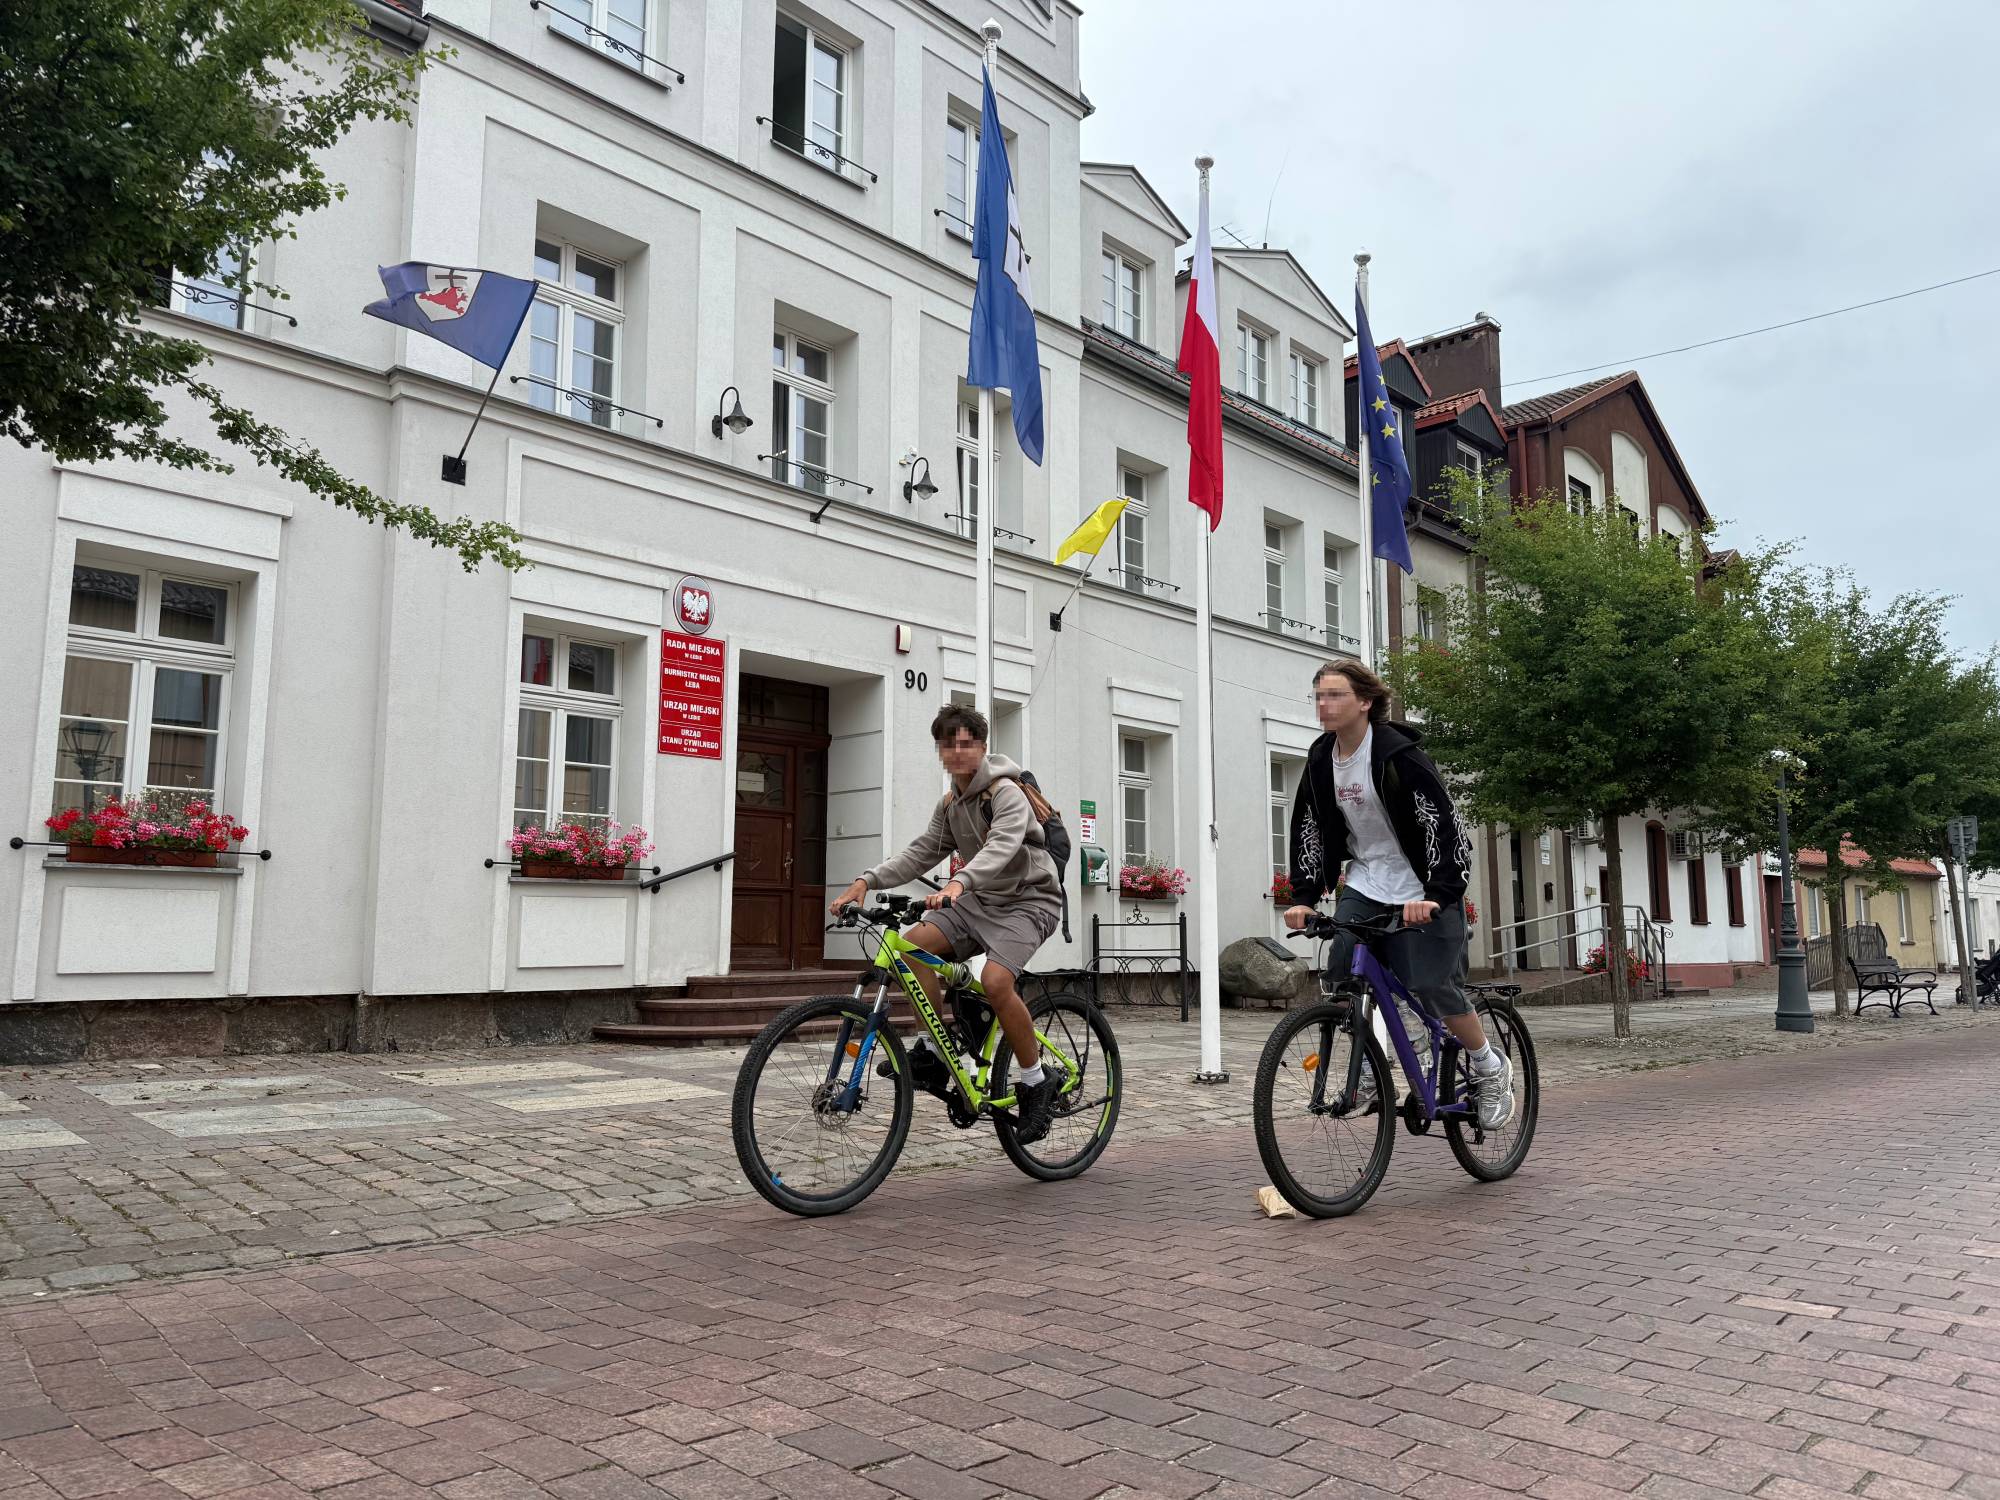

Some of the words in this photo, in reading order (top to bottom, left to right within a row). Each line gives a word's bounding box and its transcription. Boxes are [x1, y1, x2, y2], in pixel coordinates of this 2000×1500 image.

[666, 638, 687, 650] RADA
[688, 642, 720, 656] MIEJSKA
[664, 667, 698, 680] BURMISTRZ
[699, 673, 720, 683] MIASTA
[904, 669, 928, 692] 90
[685, 680, 700, 689] ŁEBA
[663, 700, 688, 712] URZĄD
[690, 704, 720, 715] MIEJSKI
[681, 729, 701, 739] URZĄD
[662, 736, 682, 745] STANU
[684, 738, 719, 750] CYWILNEGO
[908, 979, 964, 1072] ROCKRIDER
